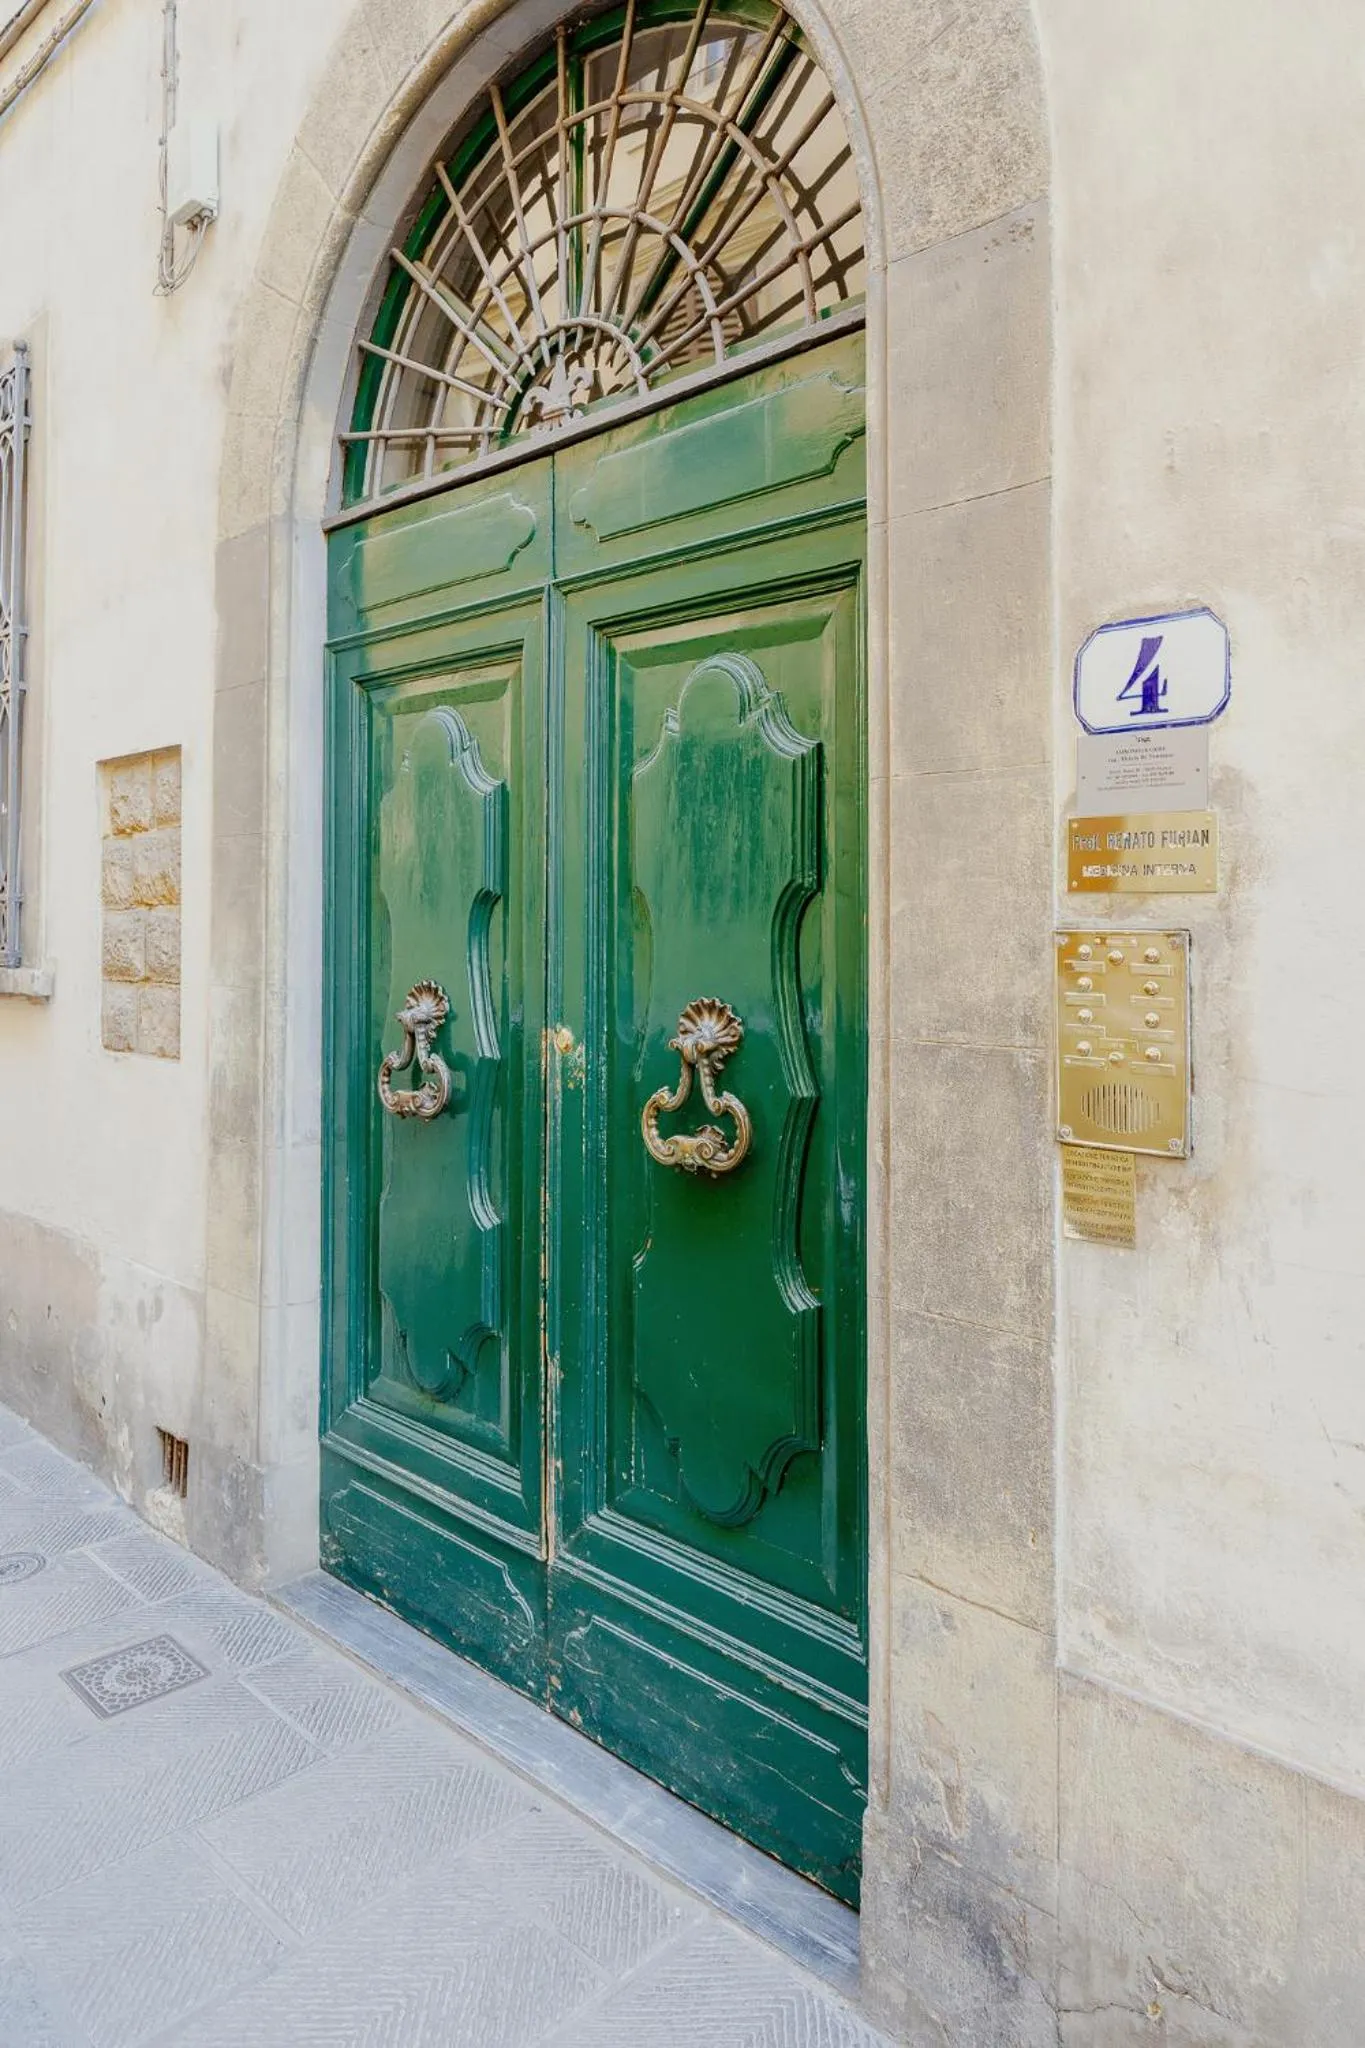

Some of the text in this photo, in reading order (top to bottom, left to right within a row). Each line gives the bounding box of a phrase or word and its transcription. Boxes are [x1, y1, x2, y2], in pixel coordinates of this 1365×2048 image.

[1116, 635, 1169, 716] 4
[1107, 831, 1155, 849] RENATO
[1161, 829, 1209, 847] FURIAN
